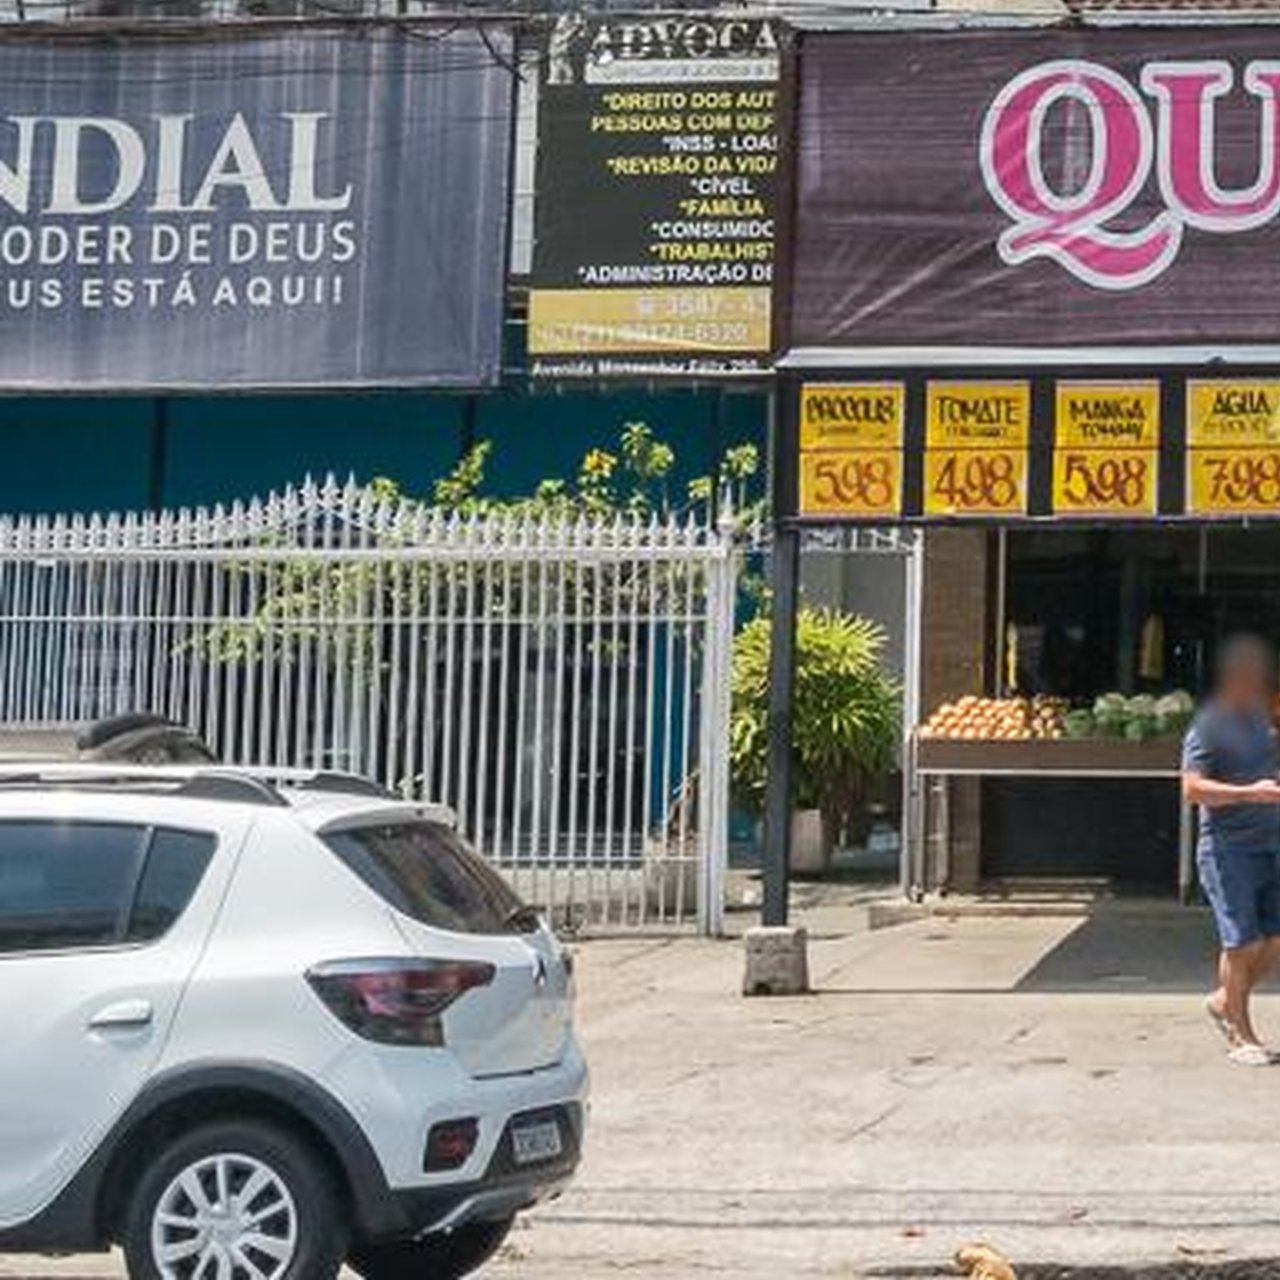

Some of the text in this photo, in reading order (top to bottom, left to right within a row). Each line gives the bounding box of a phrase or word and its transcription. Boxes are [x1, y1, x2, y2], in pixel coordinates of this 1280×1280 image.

[691, 92, 732, 108] DOS
[591, 116, 683, 132] PESSOAS
[688, 115, 731, 130] COM
[704, 156, 733, 171] DA
[2, 221, 356, 265] ODER DE DEUS
[8, 271, 343, 307] US ESTÁ AQUI!
[935, 395, 1021, 424] TOMATE
